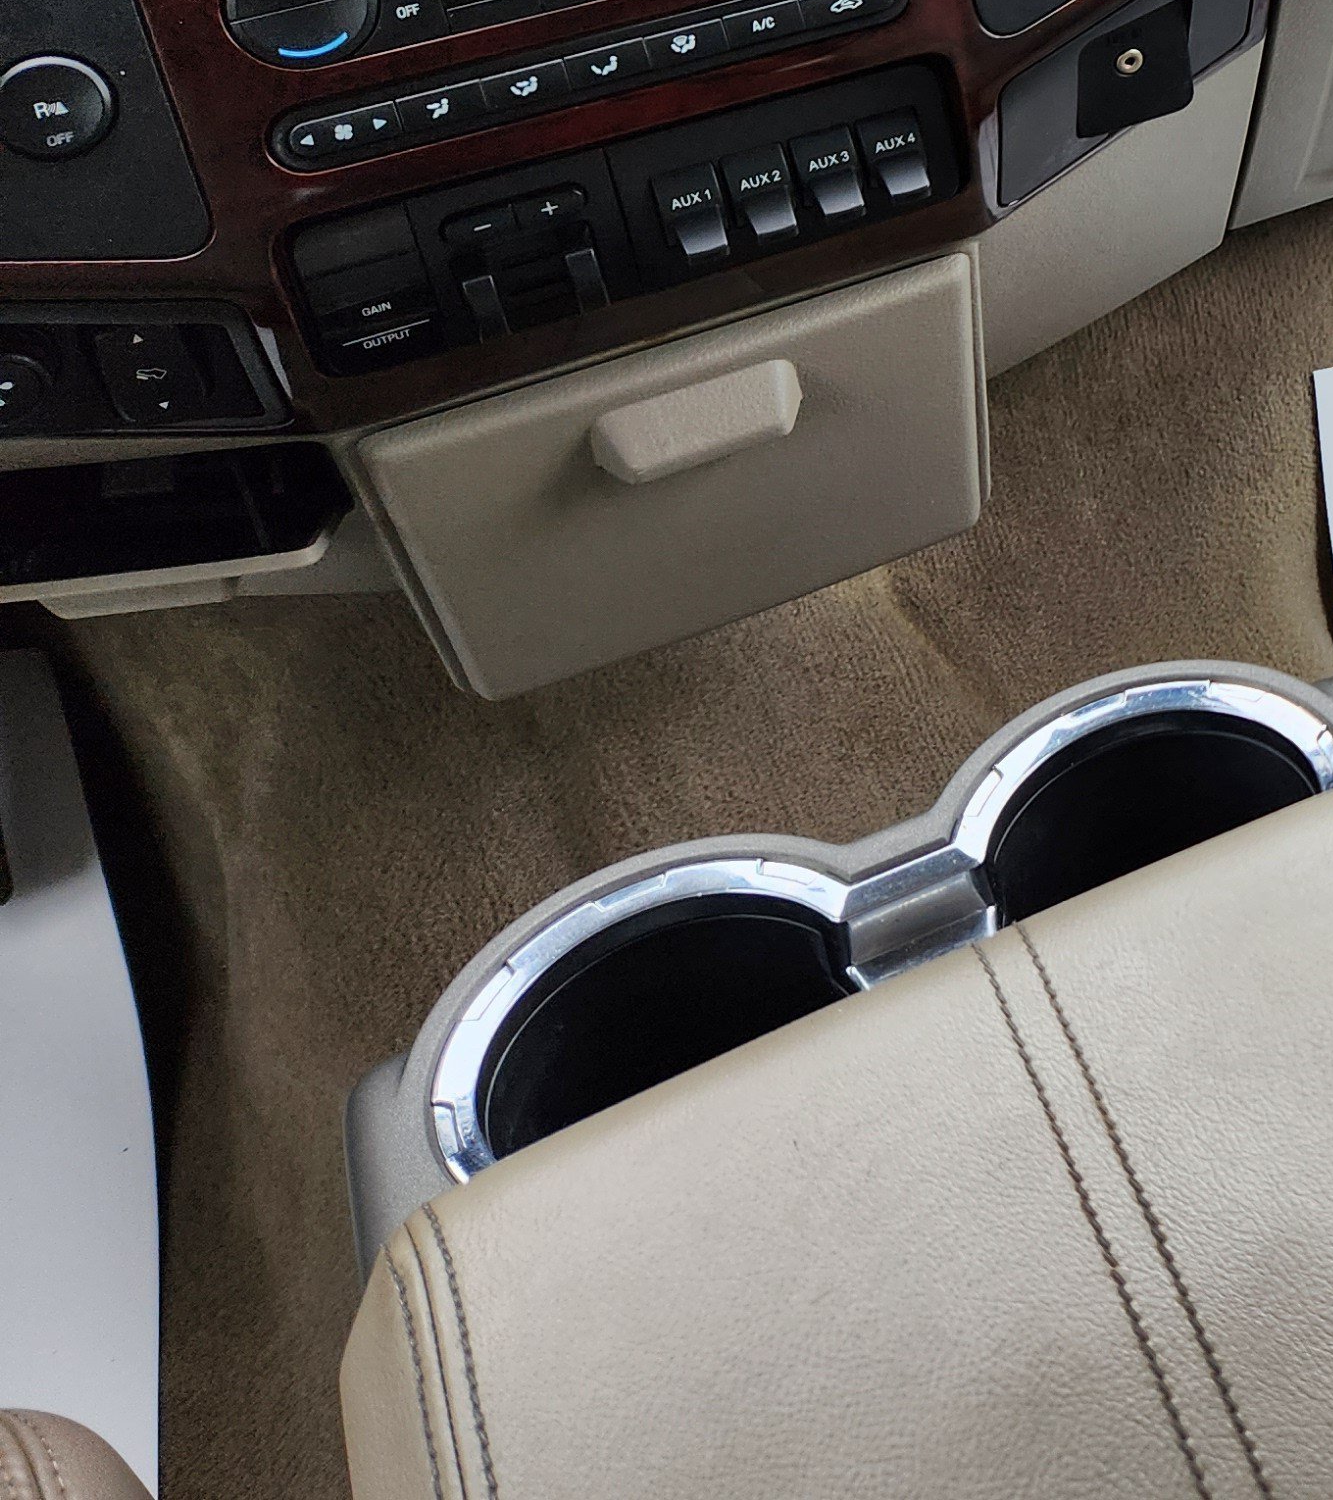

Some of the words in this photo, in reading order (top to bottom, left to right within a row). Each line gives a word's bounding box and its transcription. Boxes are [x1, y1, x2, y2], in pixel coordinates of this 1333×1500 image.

[395, 3, 421, 20] OFF
[751, 15, 776, 33] A/C
[46, 131, 75, 147] OFF
[874, 135, 906, 154] AUX
[906, 132, 916, 145] 4
[808, 153, 839, 173] AUX
[839, 150, 850, 163] 3
[739, 173, 771, 192] AUX
[771, 169, 782, 182] 2
[671, 191, 702, 211] AUX
[704, 188, 713, 201] 1
[361, 300, 392, 318] GAIN
[362, 328, 411, 350] OUTPUT
